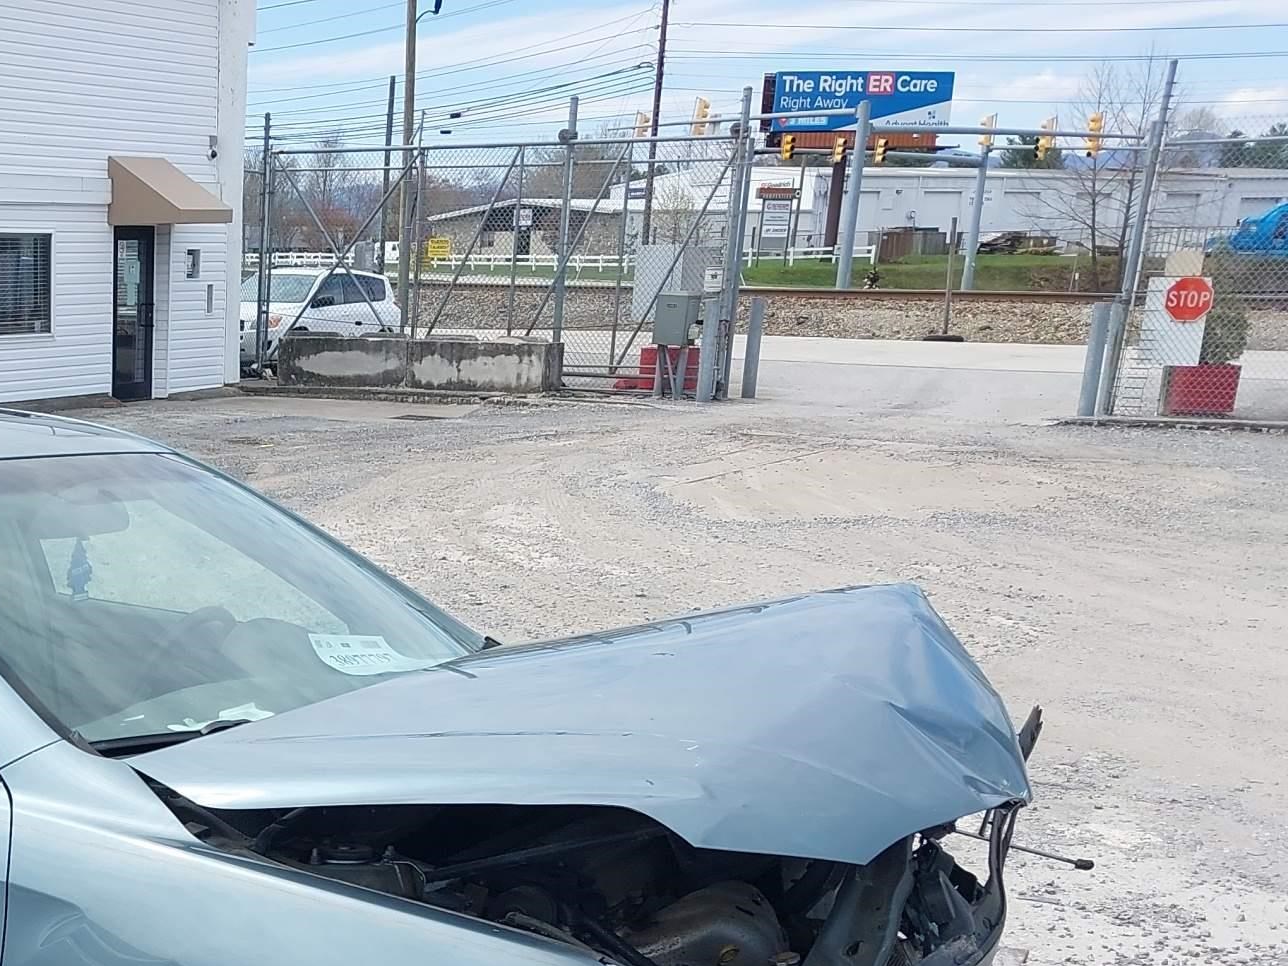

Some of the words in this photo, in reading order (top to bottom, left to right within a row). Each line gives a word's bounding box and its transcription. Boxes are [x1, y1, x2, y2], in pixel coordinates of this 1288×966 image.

[783, 75, 814, 92] The
[819, 75, 863, 97] Right
[869, 75, 894, 92] ER
[897, 75, 938, 92] Care
[780, 96, 811, 112] Right
[813, 96, 849, 110] Away
[1167, 291, 1210, 308] STOP
